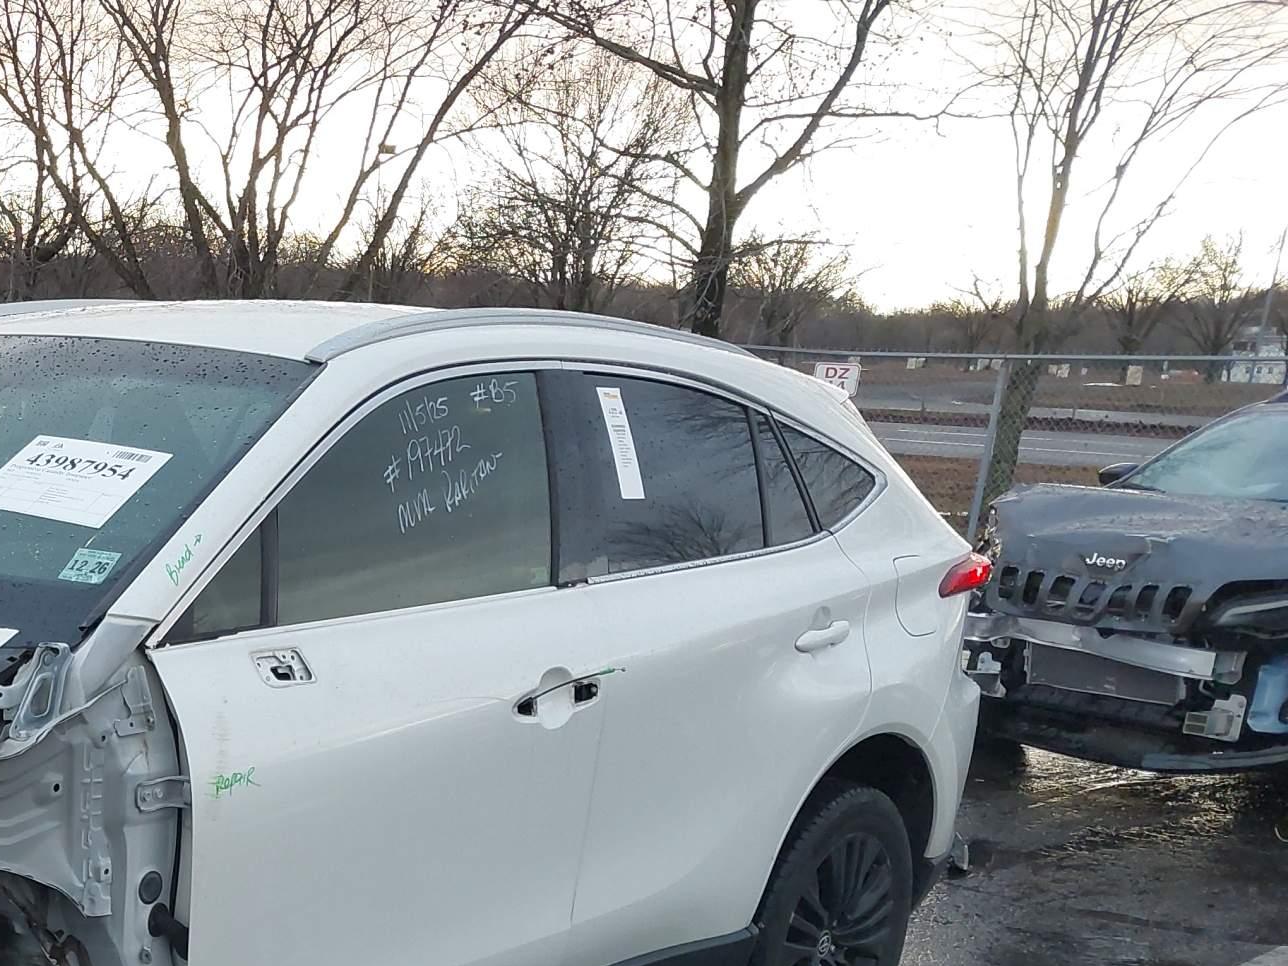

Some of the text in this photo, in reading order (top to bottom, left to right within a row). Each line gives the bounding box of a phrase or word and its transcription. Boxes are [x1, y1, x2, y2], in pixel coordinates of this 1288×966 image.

[824, 366, 851, 380] DZ
[398, 396, 449, 435] 11/5/25
[25, 452, 137, 481] 43987954
[68, 559, 110, 575] 12 26
[1085, 552, 1126, 571] Jeep
